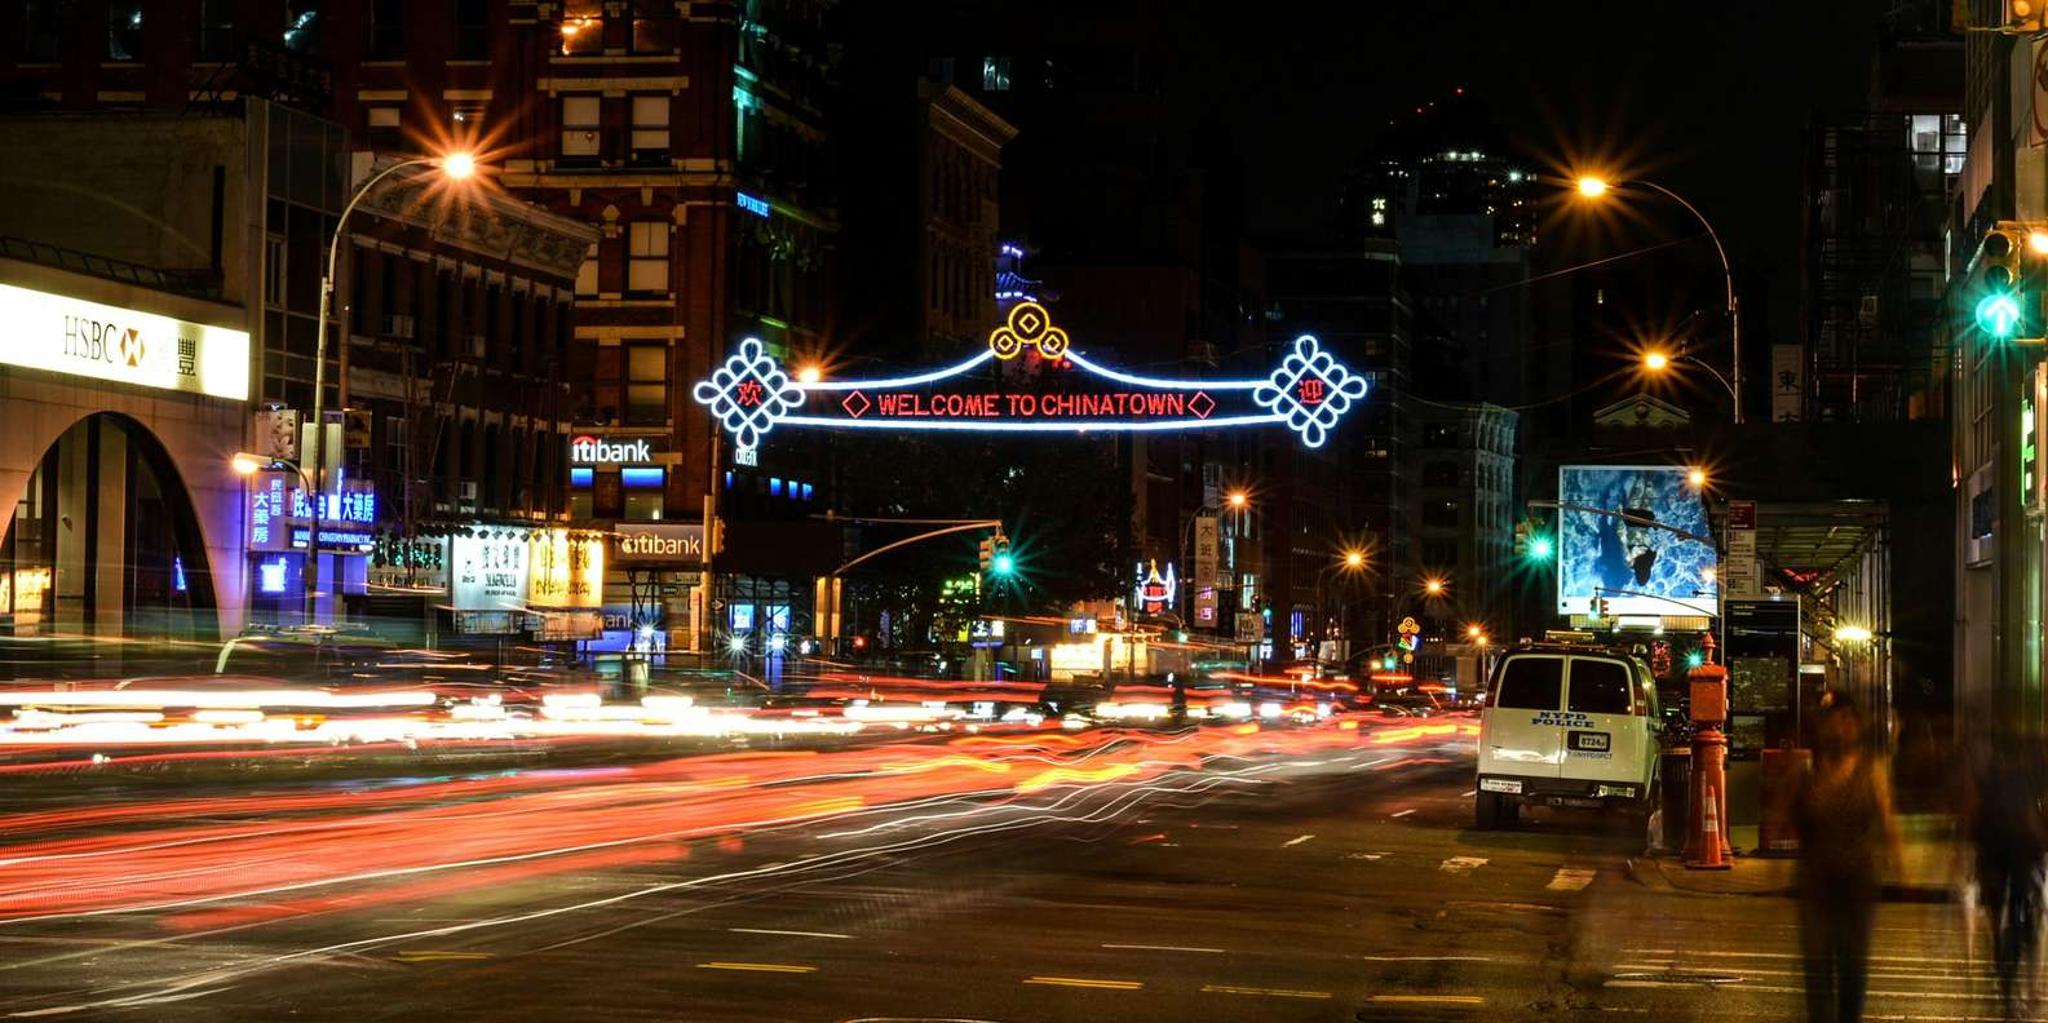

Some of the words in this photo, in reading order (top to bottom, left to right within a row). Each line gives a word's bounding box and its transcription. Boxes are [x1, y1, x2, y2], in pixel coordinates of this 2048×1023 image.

[63, 315, 116, 364] HSBC
[736, 380, 763, 406] 欢
[878, 393, 1000, 416] WELCOME
[1006, 393, 1036, 416] TO
[1041, 392, 1184, 416] CHINATOWN
[1298, 379, 1326, 405] 迎
[621, 533, 700, 555] citibank
[1531, 718, 1595, 728] POLICE
[1539, 711, 1588, 720] NYPD
